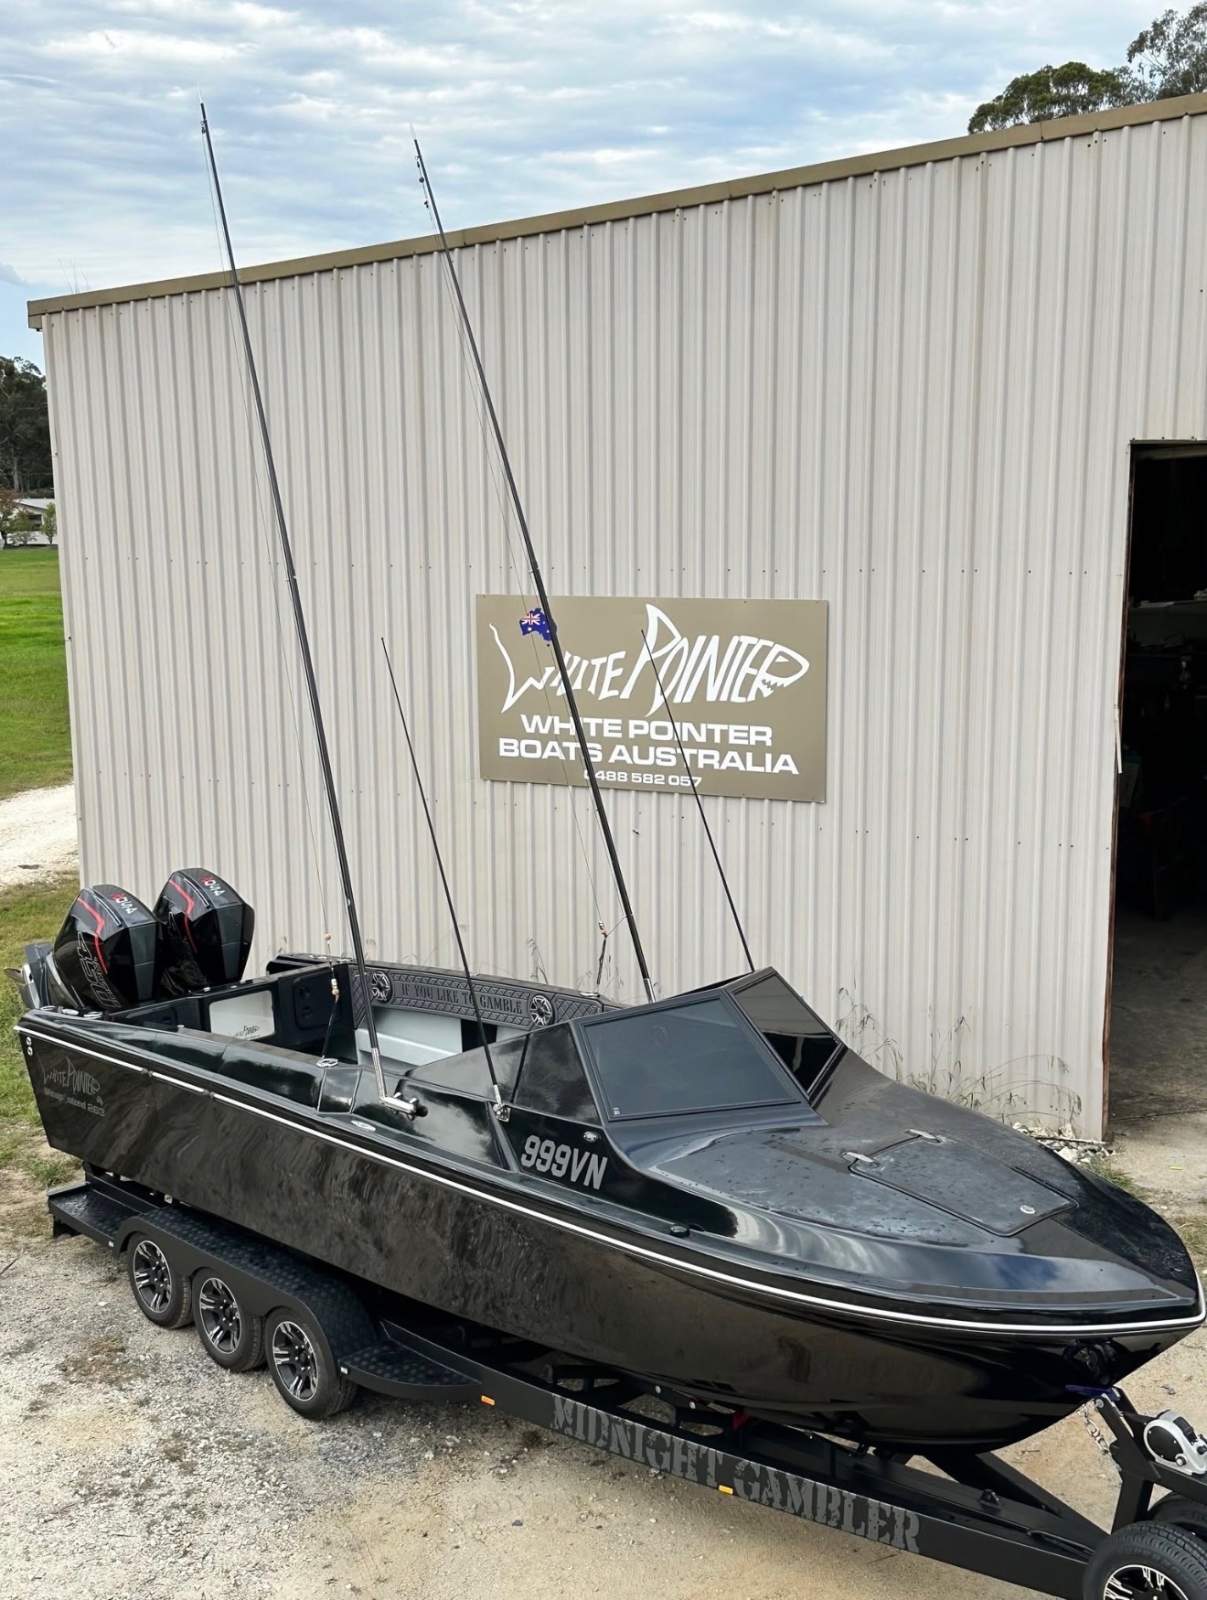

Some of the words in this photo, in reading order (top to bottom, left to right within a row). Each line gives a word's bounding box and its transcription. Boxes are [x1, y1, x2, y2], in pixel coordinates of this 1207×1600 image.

[520, 714, 623, 738] WHTE
[628, 719, 773, 747] POINTER
[499, 737, 603, 763] BOATS
[608, 744, 800, 775] AUSTRALIA
[631, 772, 666, 786] 582
[668, 774, 703, 788] 057
[414, 984, 434, 1001] YOU
[437, 986, 460, 1005] LIKE
[480, 994, 523, 1015] GAMBLE
[520, 1134, 608, 1191] 999VN
[551, 1391, 724, 1485] MIDNIGHT
[733, 1459, 921, 1554] GAMBLER
